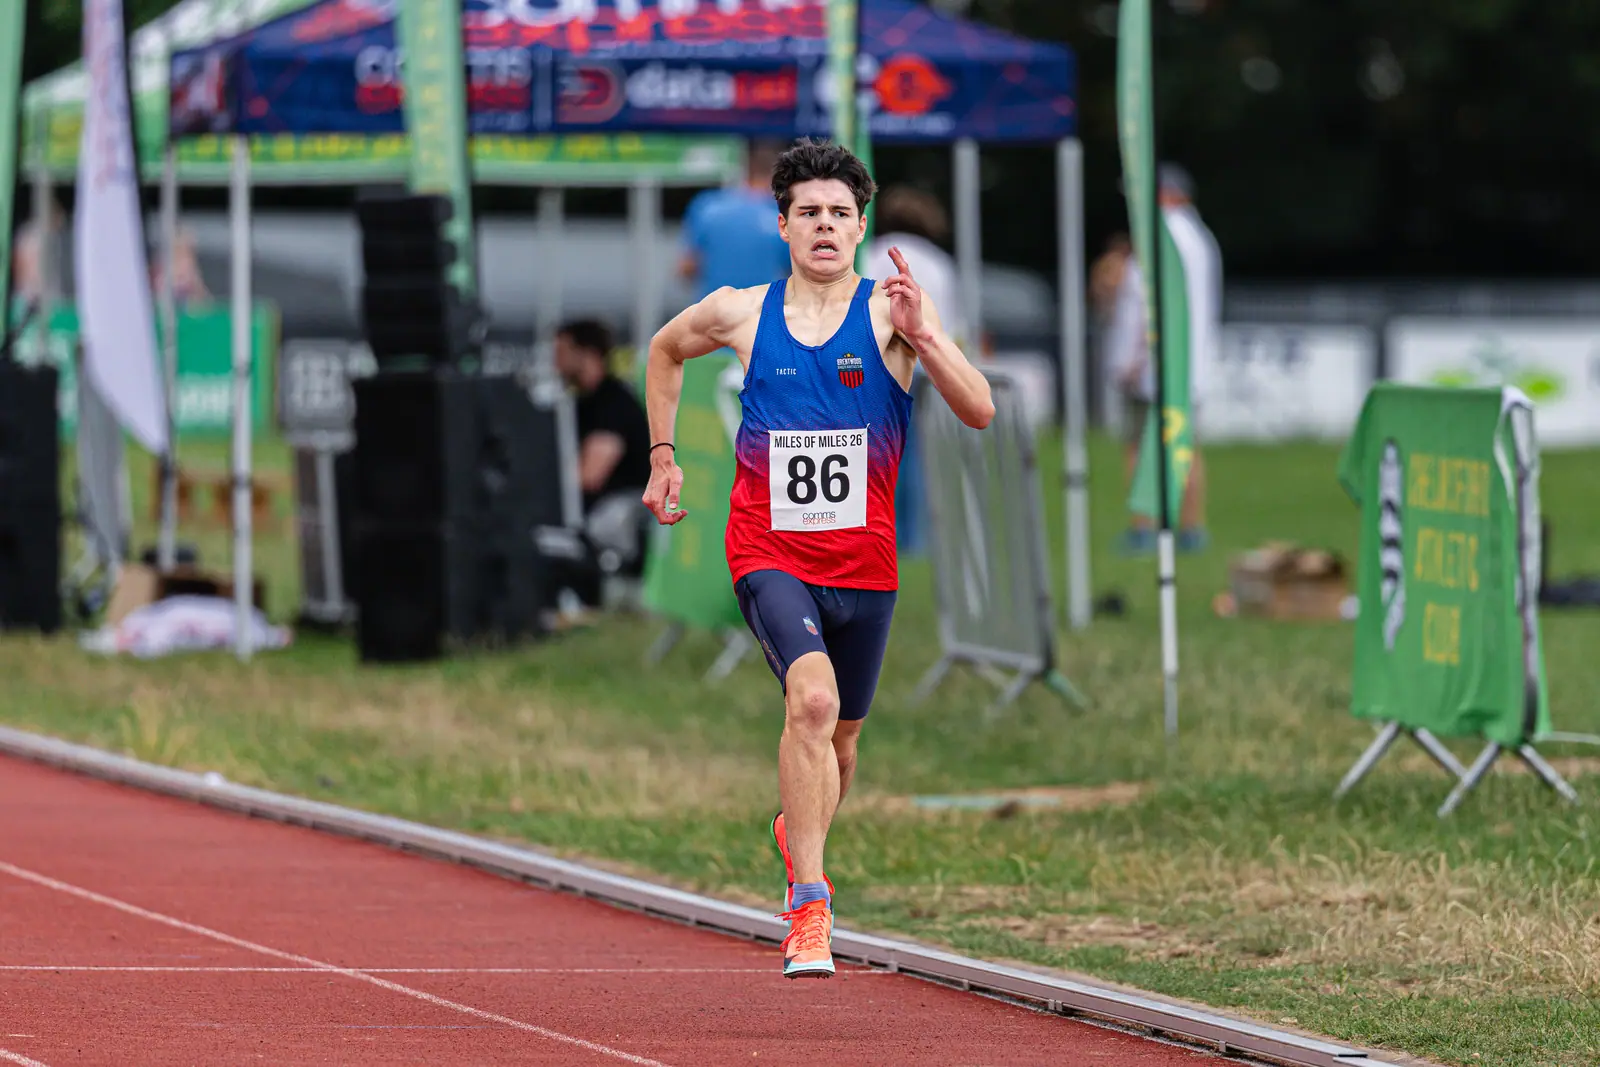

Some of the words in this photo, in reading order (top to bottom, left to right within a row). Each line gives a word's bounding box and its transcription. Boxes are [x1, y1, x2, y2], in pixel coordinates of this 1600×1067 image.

[774, 435, 802, 448] MILES
[804, 435, 816, 448] OF
[818, 434, 848, 448] MILES
[850, 433, 863, 447] 26
[786, 453, 850, 505] 86
[802, 511, 836, 520] comms
[802, 517, 836, 525] express
